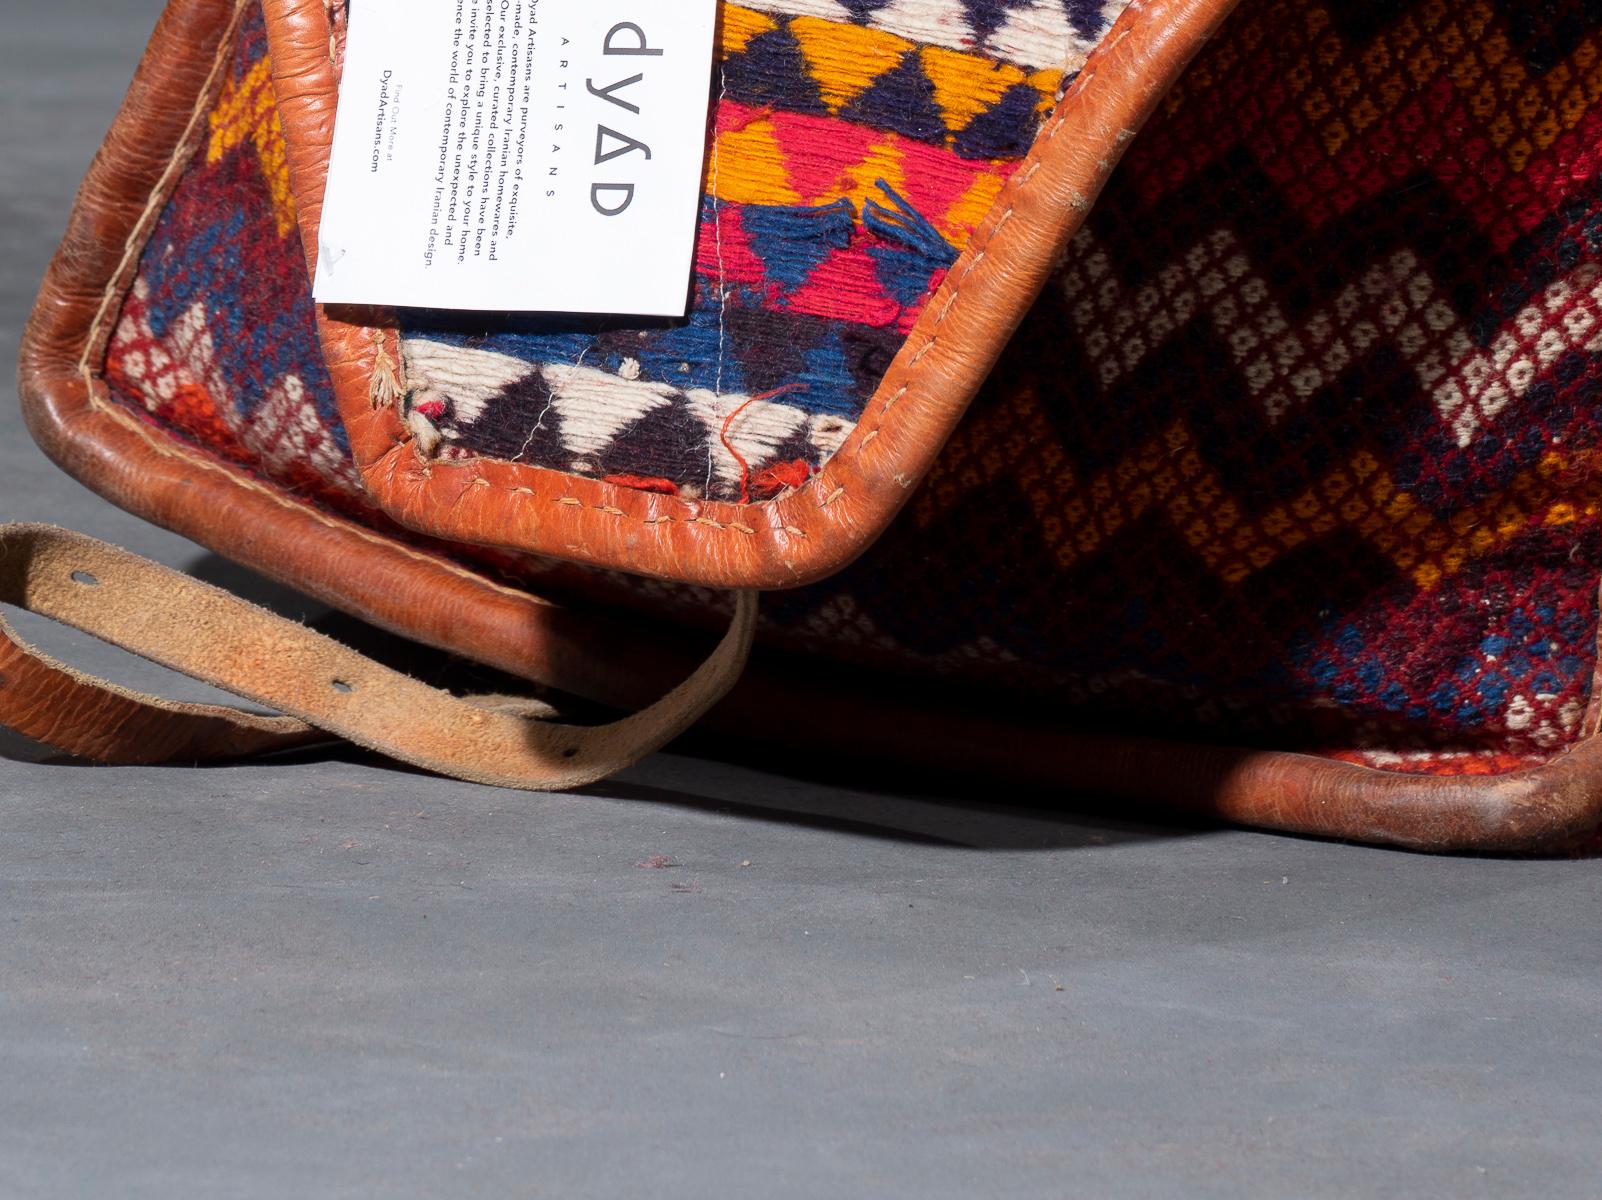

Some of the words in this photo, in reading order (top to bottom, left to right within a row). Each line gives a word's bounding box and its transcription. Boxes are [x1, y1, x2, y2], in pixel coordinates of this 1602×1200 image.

[452, 26, 464, 48] the
[467, 7, 481, 41] invite
[448, 49, 460, 84] world
[464, 43, 475, 66] you
[480, 50, 491, 64] to
[492, 24, 507, 82] exclusive,
[463, 67, 474, 82] to
[474, 66, 491, 98] bring
[502, 42, 519, 125] contemporary
[392, 83, 404, 104] Find
[446, 86, 457, 101] of
[458, 83, 471, 129] explore
[488, 84, 501, 130] curated
[521, 84, 531, 104] are
[370, 69, 393, 173] DyadArtisans.com
[389, 105, 400, 124] Out
[470, 110, 484, 151] unique
[545, 36, 570, 197] ARTISANS
[387, 125, 398, 151] More
[433, 101, 453, 184] contemporary
[455, 130, 468, 152] the
[499, 127, 514, 167] Iranian
[515, 106, 529, 166] purveyors
[466, 153, 479, 182] style
[480, 132, 497, 194] collections
[513, 167, 524, 181] of
[446, 153, 462, 222] unexpected
[465, 184, 476, 198] to
[490, 169, 510, 237] homewares
[430, 186, 446, 225] Iranian
[461, 199, 472, 228] your
[477, 196, 491, 225] have
[504, 182, 520, 240] exquisite,
[422, 227, 440, 269] design.
[443, 224, 454, 246] and
[456, 229, 472, 265] home.
[472, 227, 487, 257] been
[487, 239, 499, 262] and
